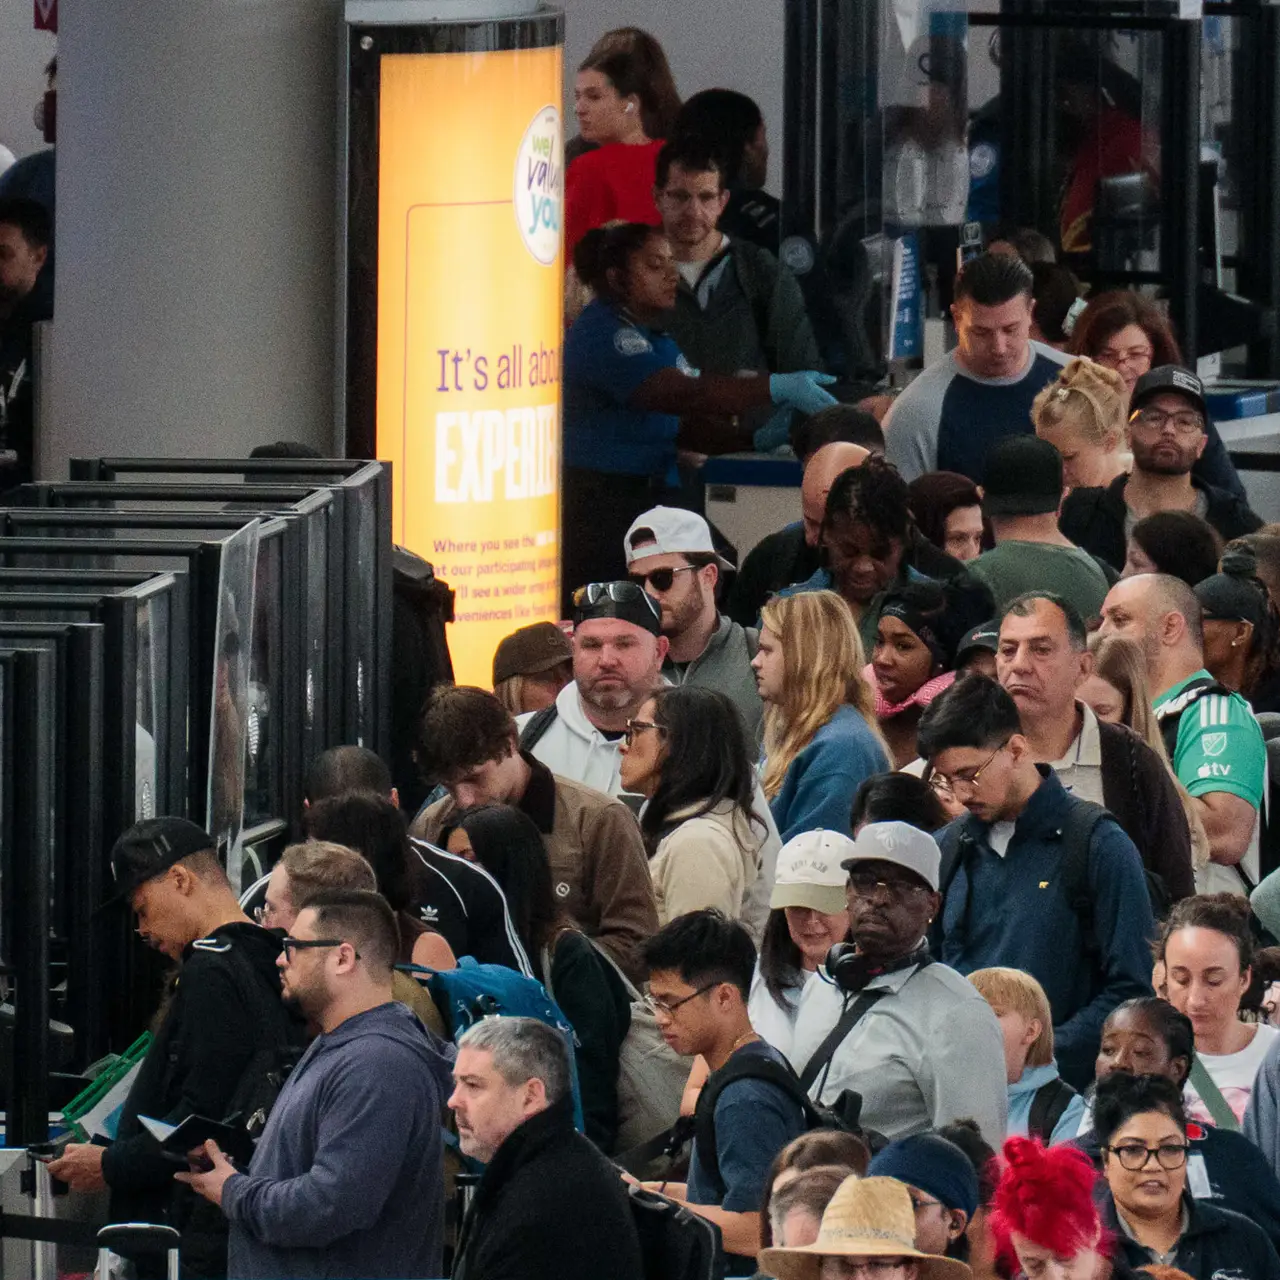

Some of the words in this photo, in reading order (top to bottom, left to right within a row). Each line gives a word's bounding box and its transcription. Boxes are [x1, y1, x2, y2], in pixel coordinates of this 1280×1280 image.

[531, 135, 551, 157] we
[437, 348, 488, 392] It's
[497, 344, 523, 389] all
[433, 539, 477, 553] Where
[481, 539, 500, 556] you
[451, 564, 473, 576] our
[1211, 762, 1231, 776] tv
